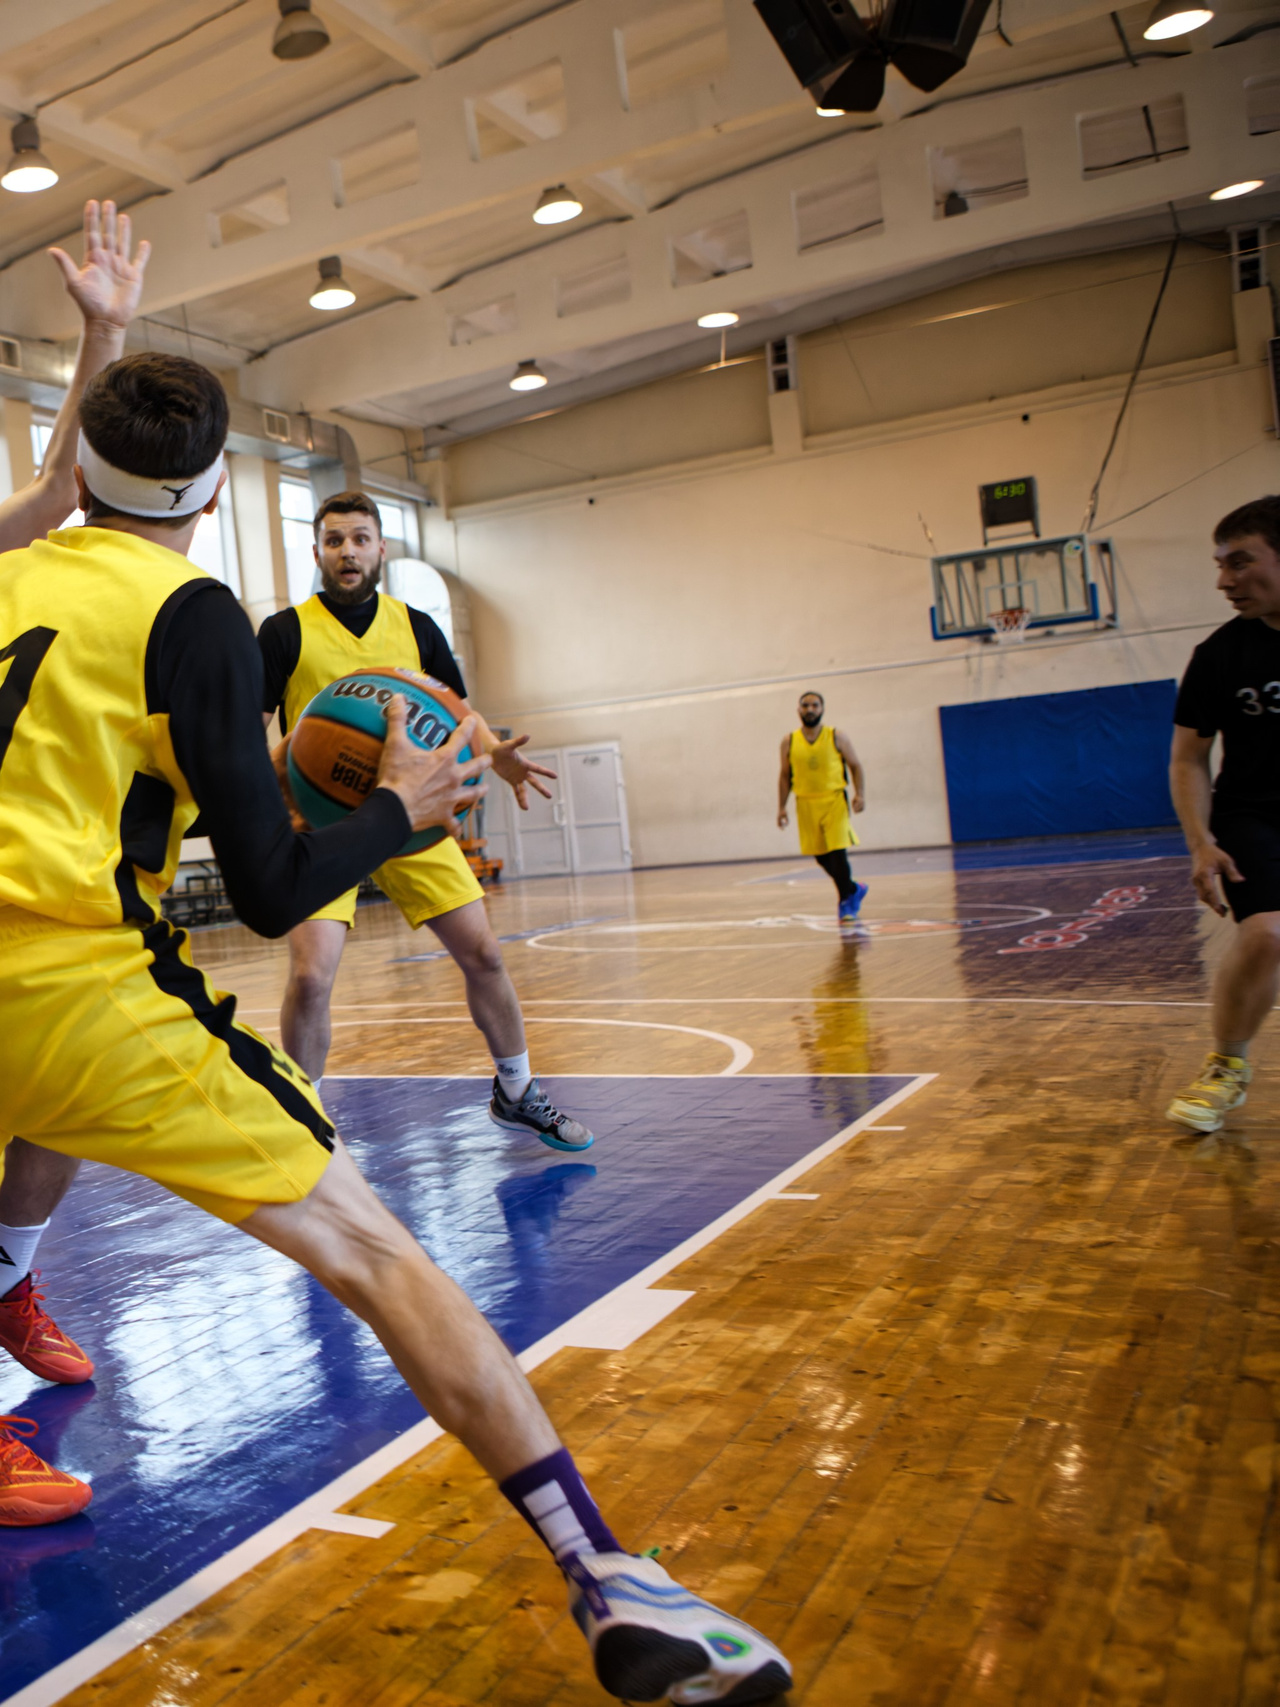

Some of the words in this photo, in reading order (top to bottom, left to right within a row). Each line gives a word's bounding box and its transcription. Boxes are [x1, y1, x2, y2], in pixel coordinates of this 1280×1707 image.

[333, 682, 451, 750] Wison
[1236, 681, 1280, 716] 33
[331, 762, 376, 796] FIBA
